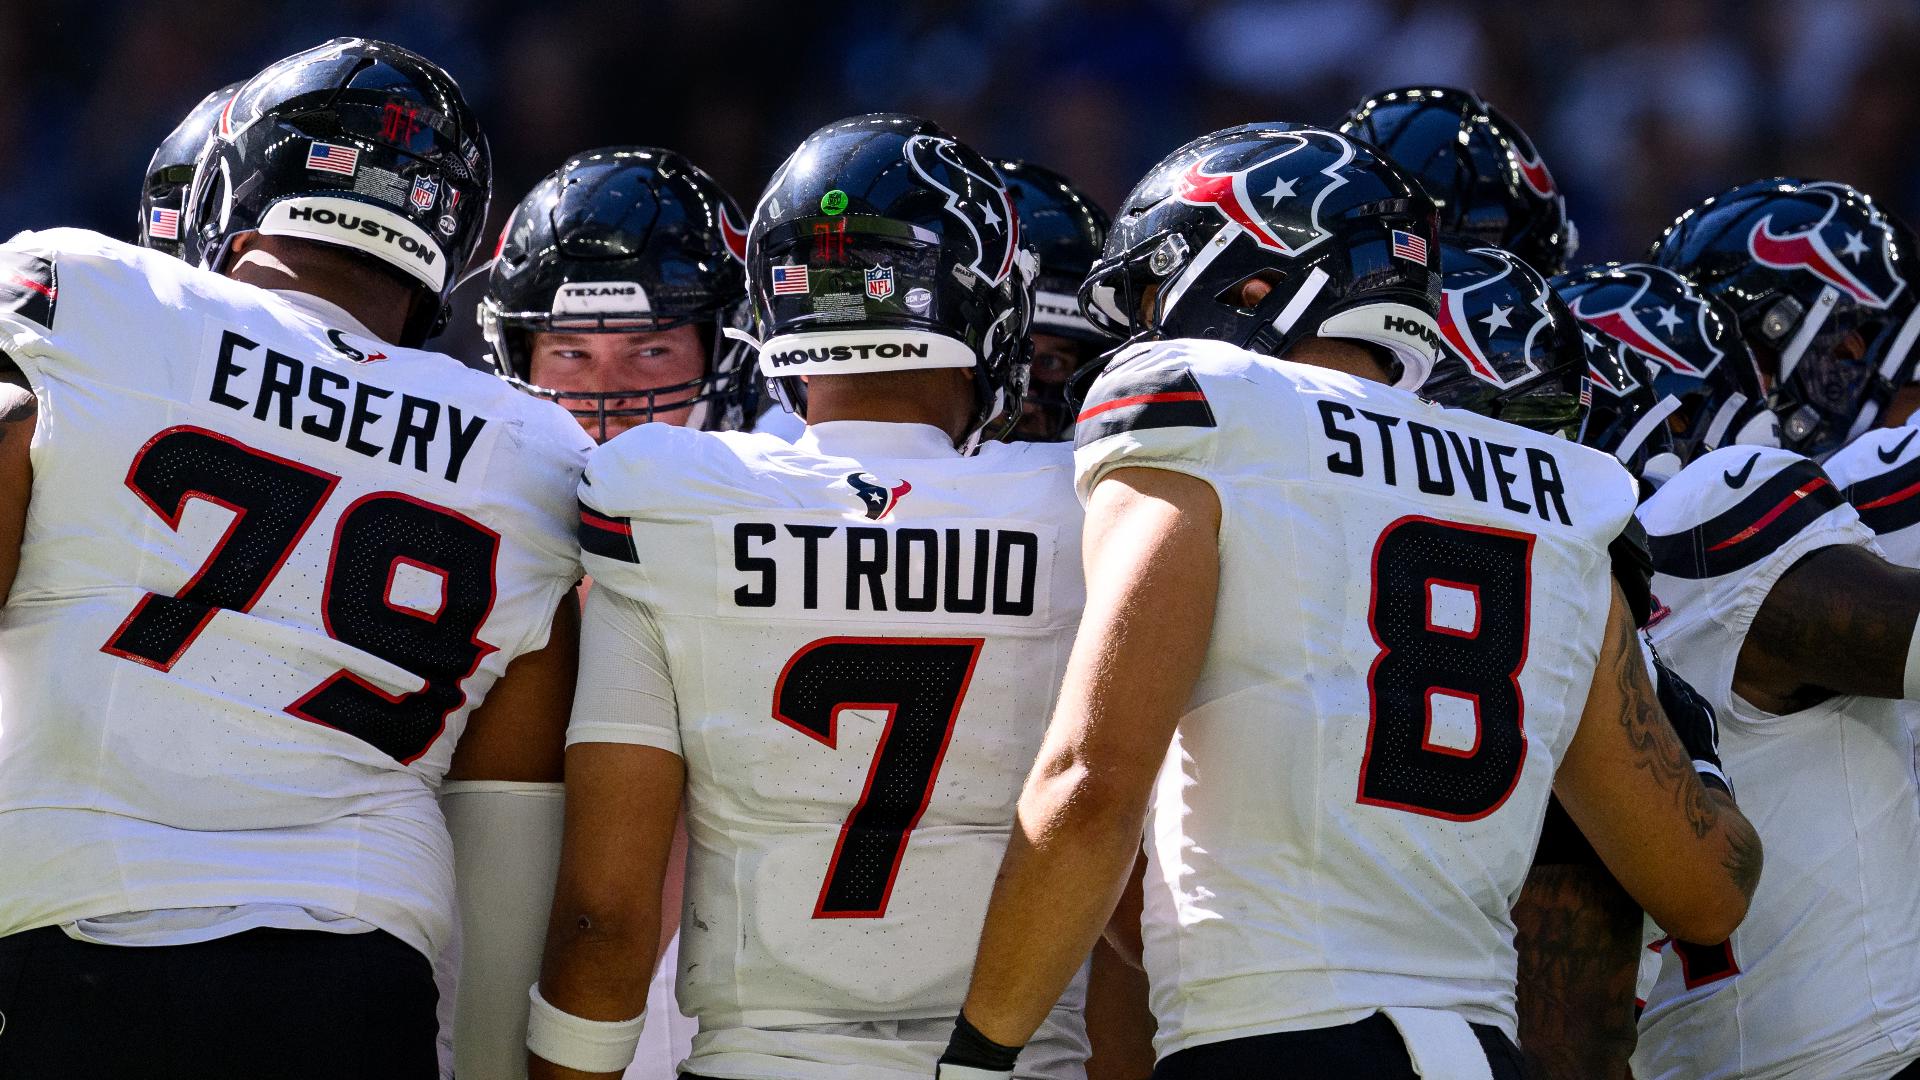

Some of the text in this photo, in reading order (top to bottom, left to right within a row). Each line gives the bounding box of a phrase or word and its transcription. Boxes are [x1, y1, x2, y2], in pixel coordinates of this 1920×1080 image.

[289, 206, 436, 267] HOUSTON
[413, 187, 433, 206] NFL
[564, 287, 636, 297] TEXANS
[869, 280, 891, 295] NFL
[770, 343, 929, 368] HOUSTON
[208, 328, 487, 484] ERSERY
[1316, 399, 1573, 526] STOVER
[100, 424, 501, 767] 79
[733, 522, 1039, 617] STROUD
[1355, 513, 1537, 823] 8
[771, 635, 986, 920] 7
